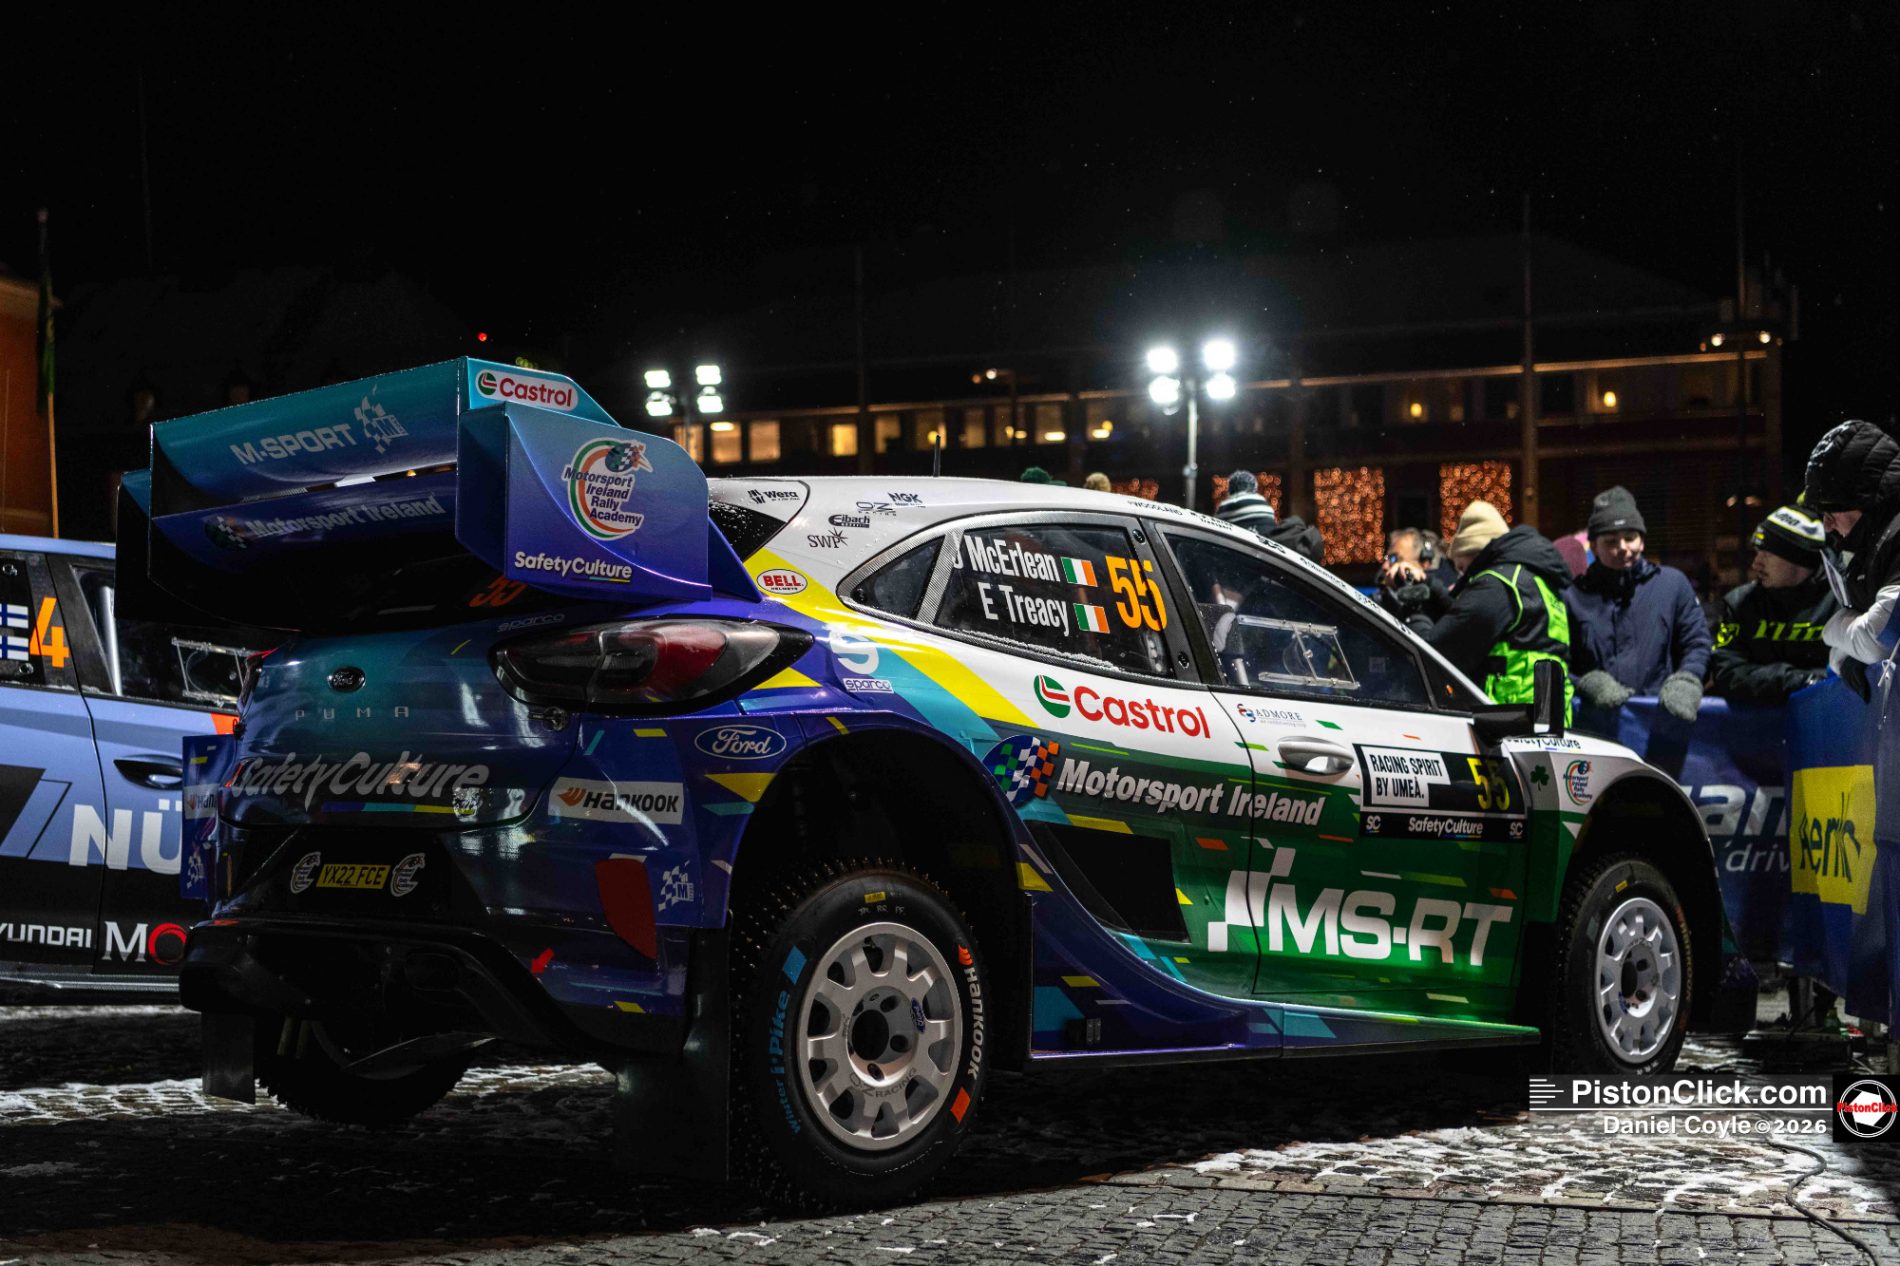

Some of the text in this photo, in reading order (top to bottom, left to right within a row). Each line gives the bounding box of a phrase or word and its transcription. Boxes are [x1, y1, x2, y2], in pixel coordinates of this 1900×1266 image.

[500, 377, 572, 407] Castrol
[564, 467, 633, 488] Motorsport
[586, 482, 630, 499] Ireland
[763, 490, 799, 500] Wera
[888, 492, 923, 504] NGK
[591, 495, 620, 511] Rally
[248, 496, 447, 538] Motorsport Ireland
[589, 509, 642, 527] Academy
[807, 534, 842, 549] SWP
[515, 551, 633, 578] SafetyCulture
[952, 532, 1061, 583] J McErlean
[763, 575, 802, 587] BELL
[1105, 555, 1168, 632] 55
[977, 581, 1070, 637] E Treacy
[29, 596, 71, 669] 4
[845, 678, 892, 692] sparco
[295, 705, 409, 720] PUMA
[1073, 685, 1212, 740] Castrol
[711, 728, 773, 756] Ford
[1369, 753, 1444, 778] RACING SPIRIT
[231, 750, 490, 811] SafetyCulture
[1375, 776, 1426, 799] BY UMEÅ.
[1466, 757, 1511, 811] 55
[1056, 757, 1326, 827] Motorsport Ireland
[1366, 815, 1382, 831] SC
[1408, 816, 1484, 837] SafetyCulture
[1509, 822, 1524, 837] SC
[321, 866, 356, 885] YX22
[357, 866, 386, 886] FCE
